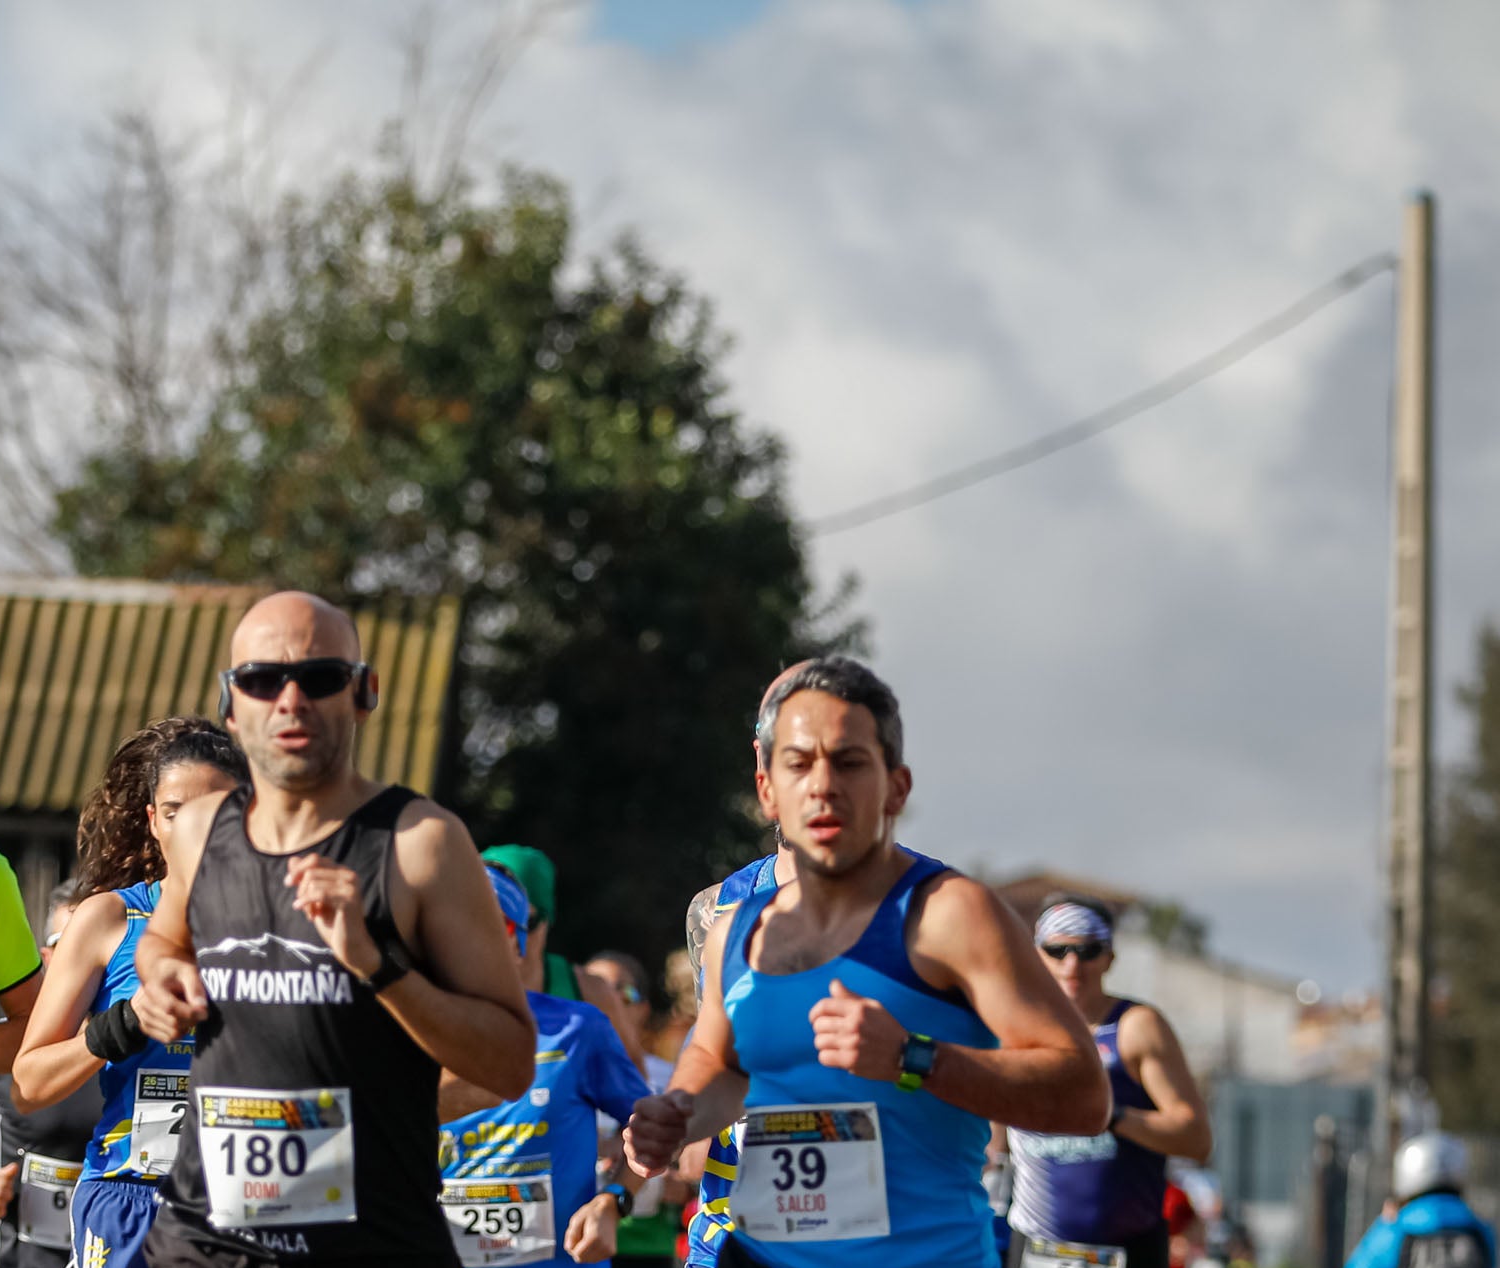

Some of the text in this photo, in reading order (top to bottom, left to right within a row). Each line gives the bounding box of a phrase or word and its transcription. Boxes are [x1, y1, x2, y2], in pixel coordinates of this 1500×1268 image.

[235, 964, 354, 1004] MONTAÑA
[165, 1044, 196, 1055] TRA
[143, 1076, 157, 1086] 26
[220, 1133, 307, 1178] 180
[771, 1146, 827, 1192] 39
[243, 1181, 280, 1200] DOMI
[464, 1207, 524, 1236] 259
